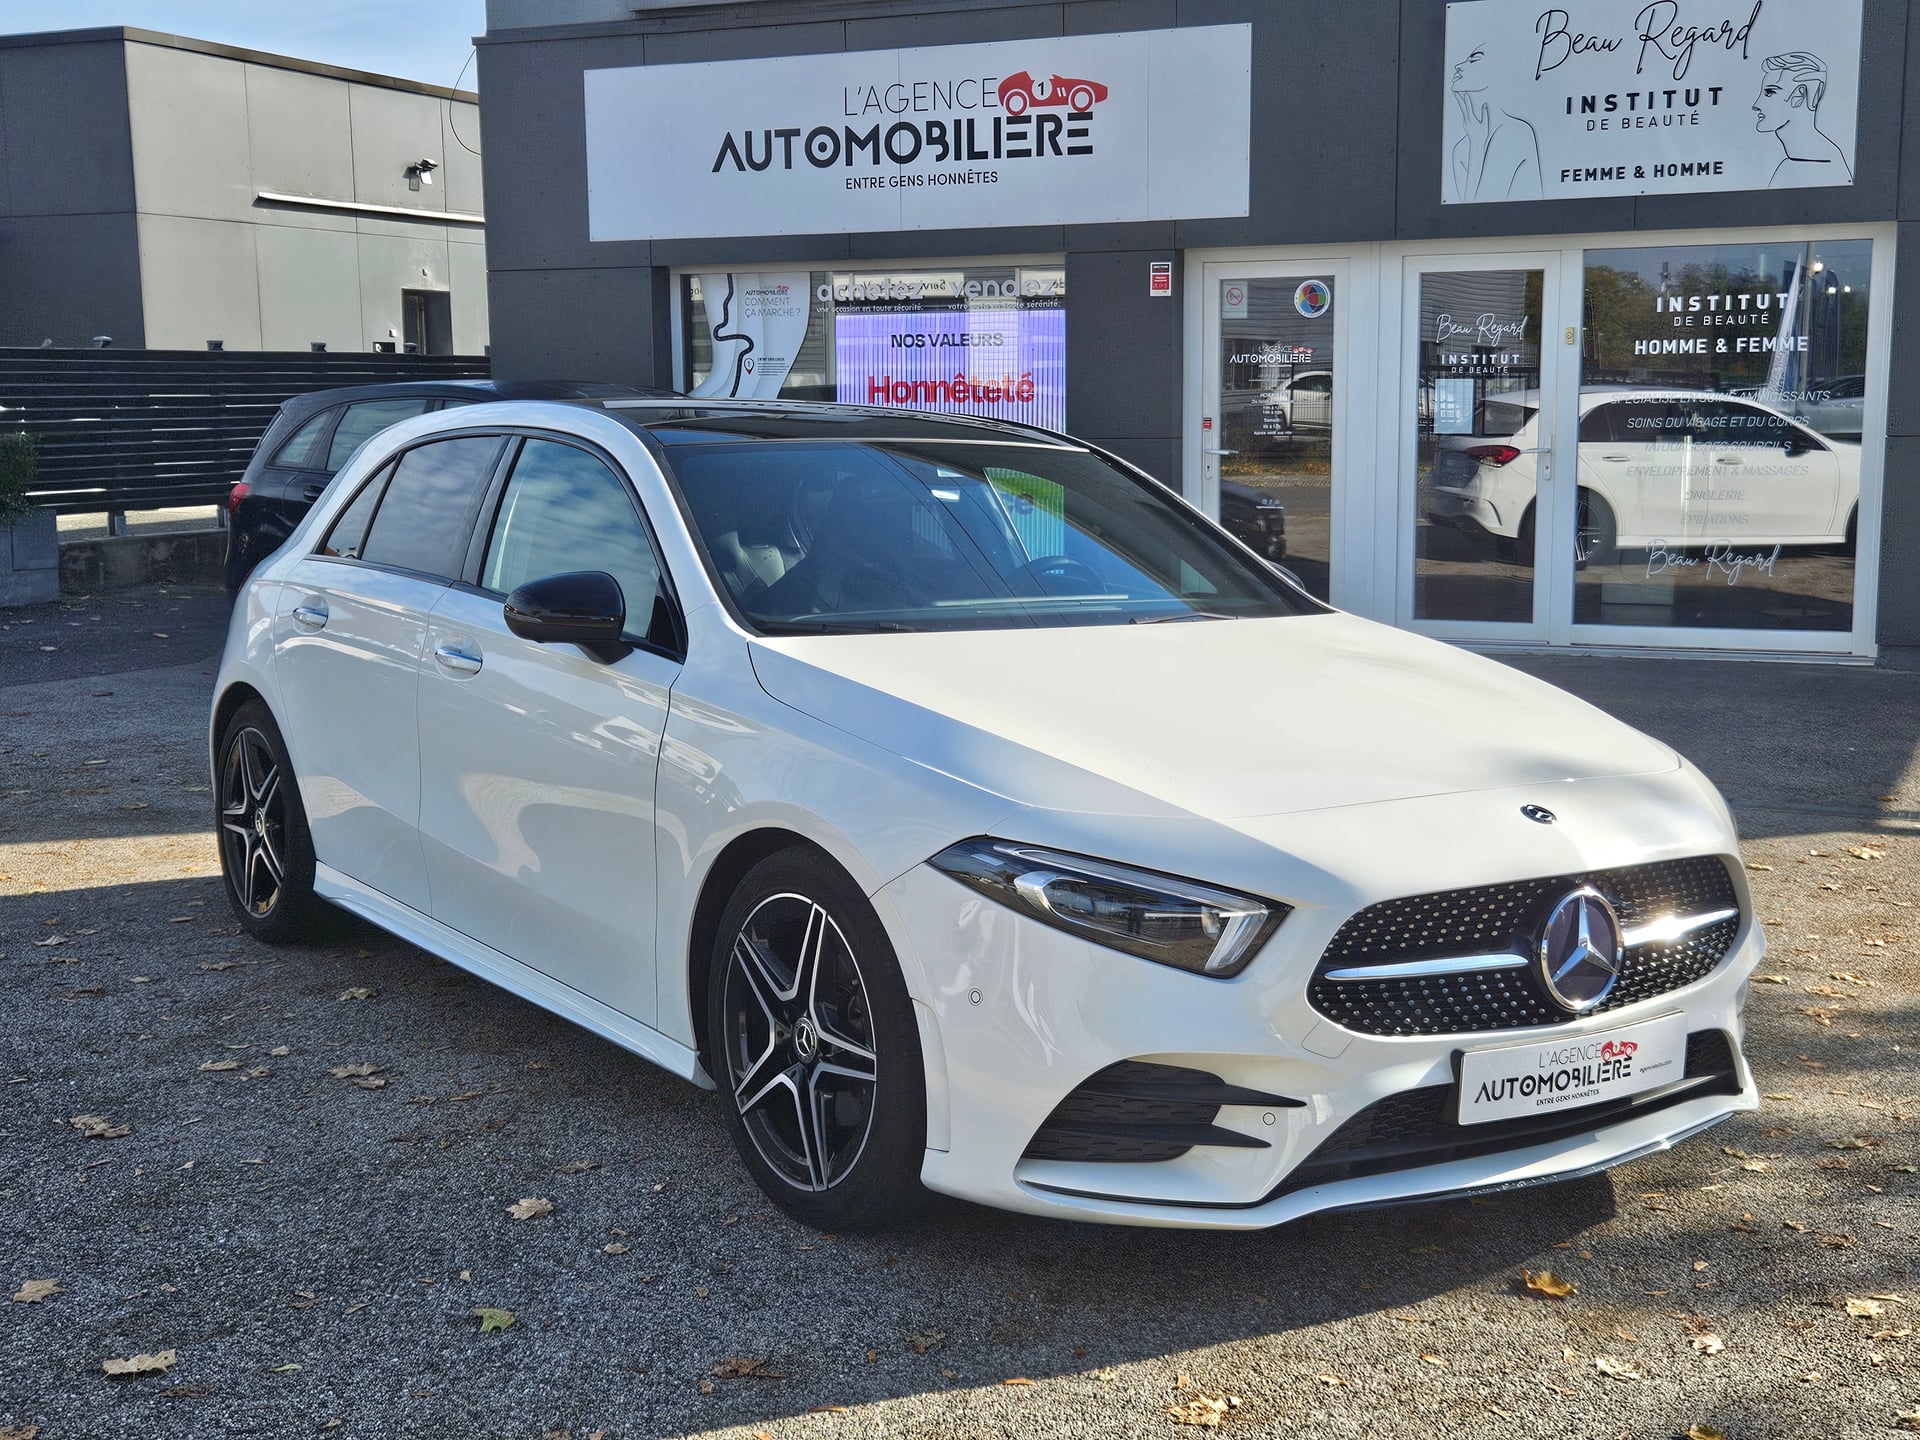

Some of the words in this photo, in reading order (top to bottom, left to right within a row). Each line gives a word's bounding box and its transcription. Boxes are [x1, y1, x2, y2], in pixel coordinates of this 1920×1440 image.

[1535, 9, 1623, 81] Beau
[1634, 0, 1762, 81] Regard
[844, 77, 998, 116] L'AGENCE
[1565, 87, 1723, 115] INSTITUT
[1586, 118, 1610, 132] DE
[1621, 110, 1700, 129] BEAUTÉ
[845, 176, 886, 190] ENTRE
[888, 174, 924, 188] GENS
[927, 168, 999, 186] HONNÊTES
[1560, 166, 1627, 183] FEMME
[1633, 165, 1646, 179] &
[1653, 161, 1724, 178] HOMME
[816, 272, 924, 302] achetez
[949, 267, 1057, 298] vendez
[744, 297, 790, 306] COMMENT
[831, 305, 861, 313] occasion
[872, 304, 892, 312] toute
[948, 303, 968, 311] votre
[1026, 298, 1061, 308] sérénité.
[1656, 293, 1789, 313] INSTITUT
[744, 308, 758, 318] ÇA
[758, 308, 794, 317] MARCHE
[1673, 316, 1694, 327] DE
[1703, 312, 1769, 326] BEAUTÉ
[1436, 313, 1473, 344] Beau
[1476, 313, 1529, 347] Regard
[891, 333, 926, 348] NOS
[928, 332, 1004, 347] VALEURS
[1634, 338, 1708, 355] HOMME
[1715, 337, 1728, 353] &
[1736, 336, 1809, 353] FEMME
[1441, 354, 1520, 365] INSTITUT
[1451, 366, 1464, 374] DE
[868, 371, 1035, 404] Honnêteté
[1627, 417, 1664, 428] SOINS
[1665, 417, 1683, 428] DU
[1685, 416, 1727, 428] VISAGE
[1729, 416, 1746, 428] ET
[1747, 416, 1766, 427] DU
[1767, 415, 1810, 427] CORPS
[1732, 440, 1792, 451] SOURCILS
[1626, 465, 1731, 476] ENVELOPPEMENT
[1742, 465, 1809, 476] MASSAGES
[1684, 489, 1745, 501] ONGLERIE
[1645, 538, 1699, 579] Beau
[1704, 538, 1783, 586] Regard
[1538, 1042, 1602, 1069] L'AGENCE
[1536, 1096, 1555, 1106] ENTRE
[1555, 1094, 1571, 1103] GENS
